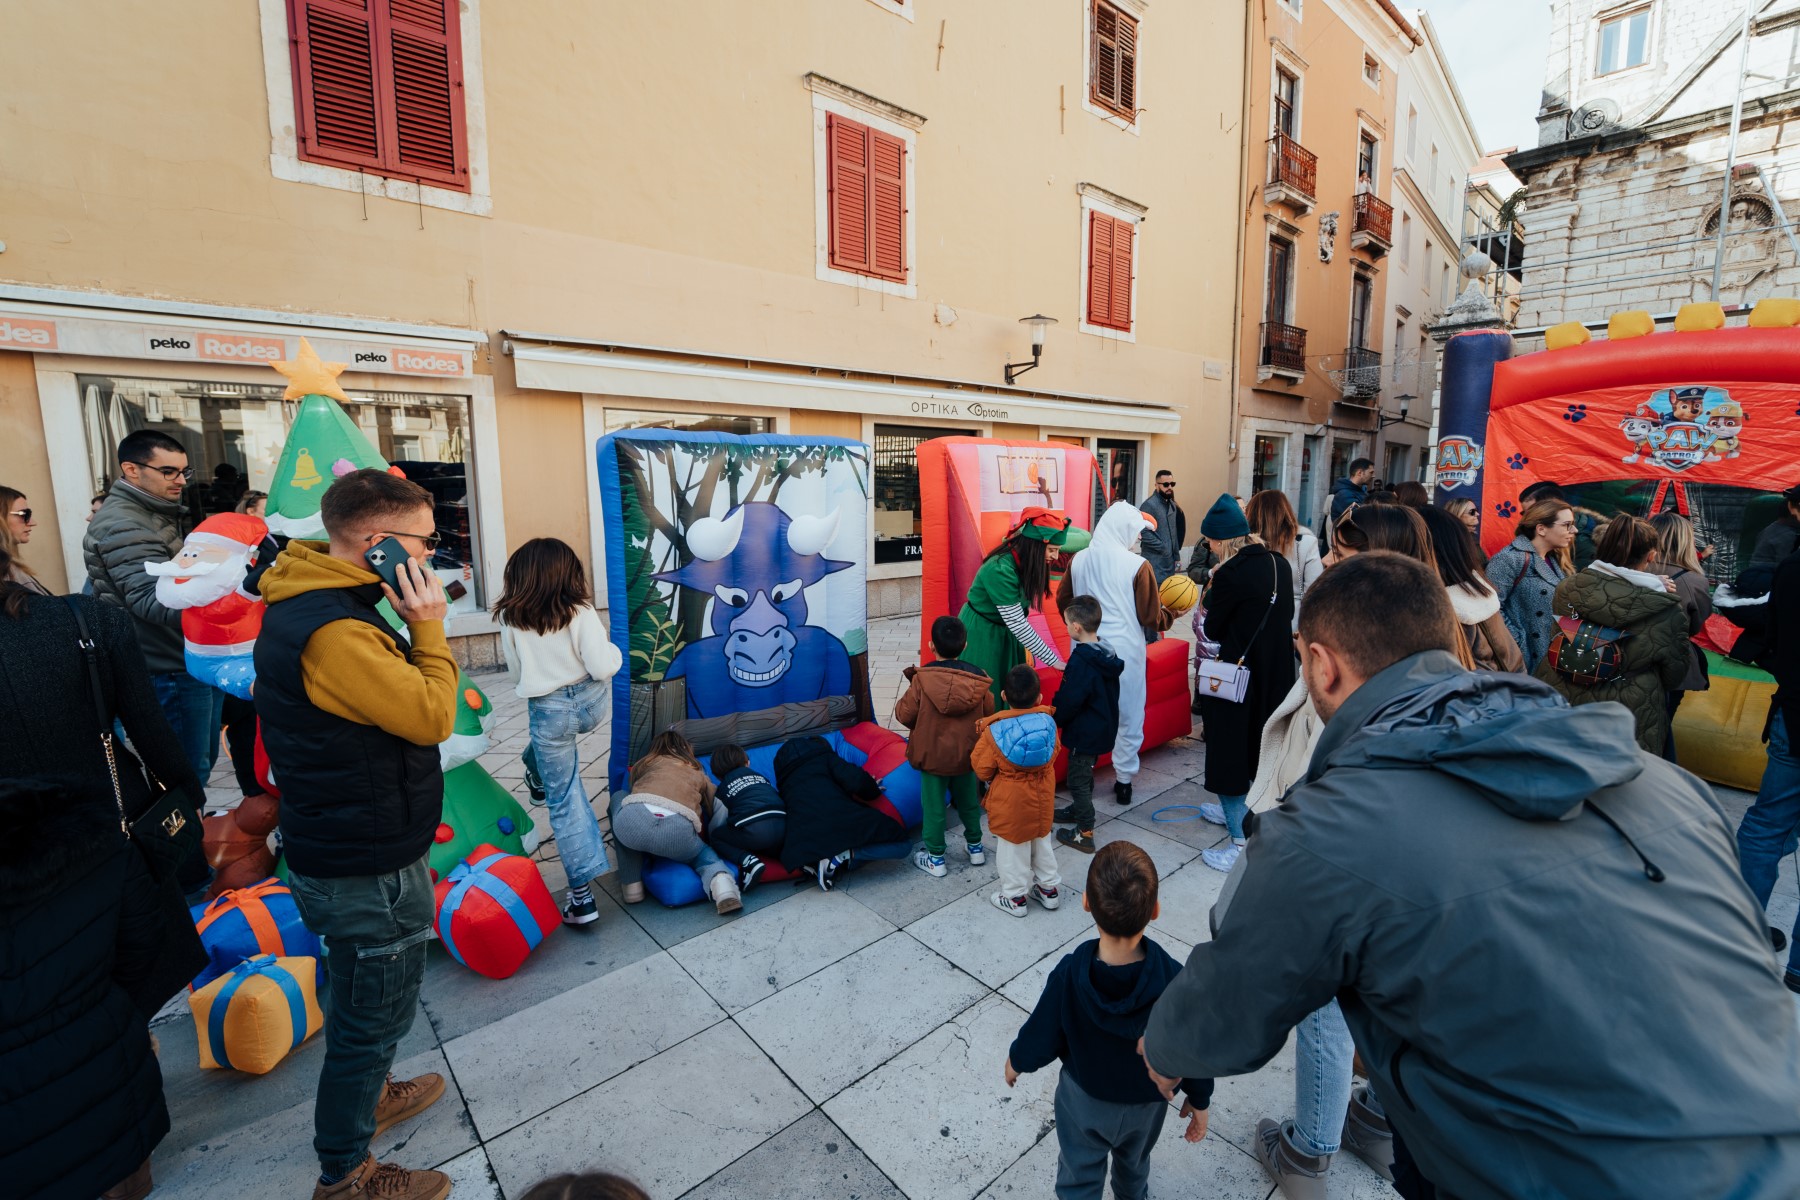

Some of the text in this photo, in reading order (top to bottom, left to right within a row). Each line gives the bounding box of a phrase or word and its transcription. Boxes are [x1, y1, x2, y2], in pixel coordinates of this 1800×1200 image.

[150, 338, 281, 359] peko Rodea
[355, 352, 460, 372] peko Rodea
[911, 402, 1009, 419] OPTIKA Optotim
[1646, 428, 1719, 451] PAW
[1436, 443, 1484, 469] AW
[1660, 451, 1698, 460] PATROL
